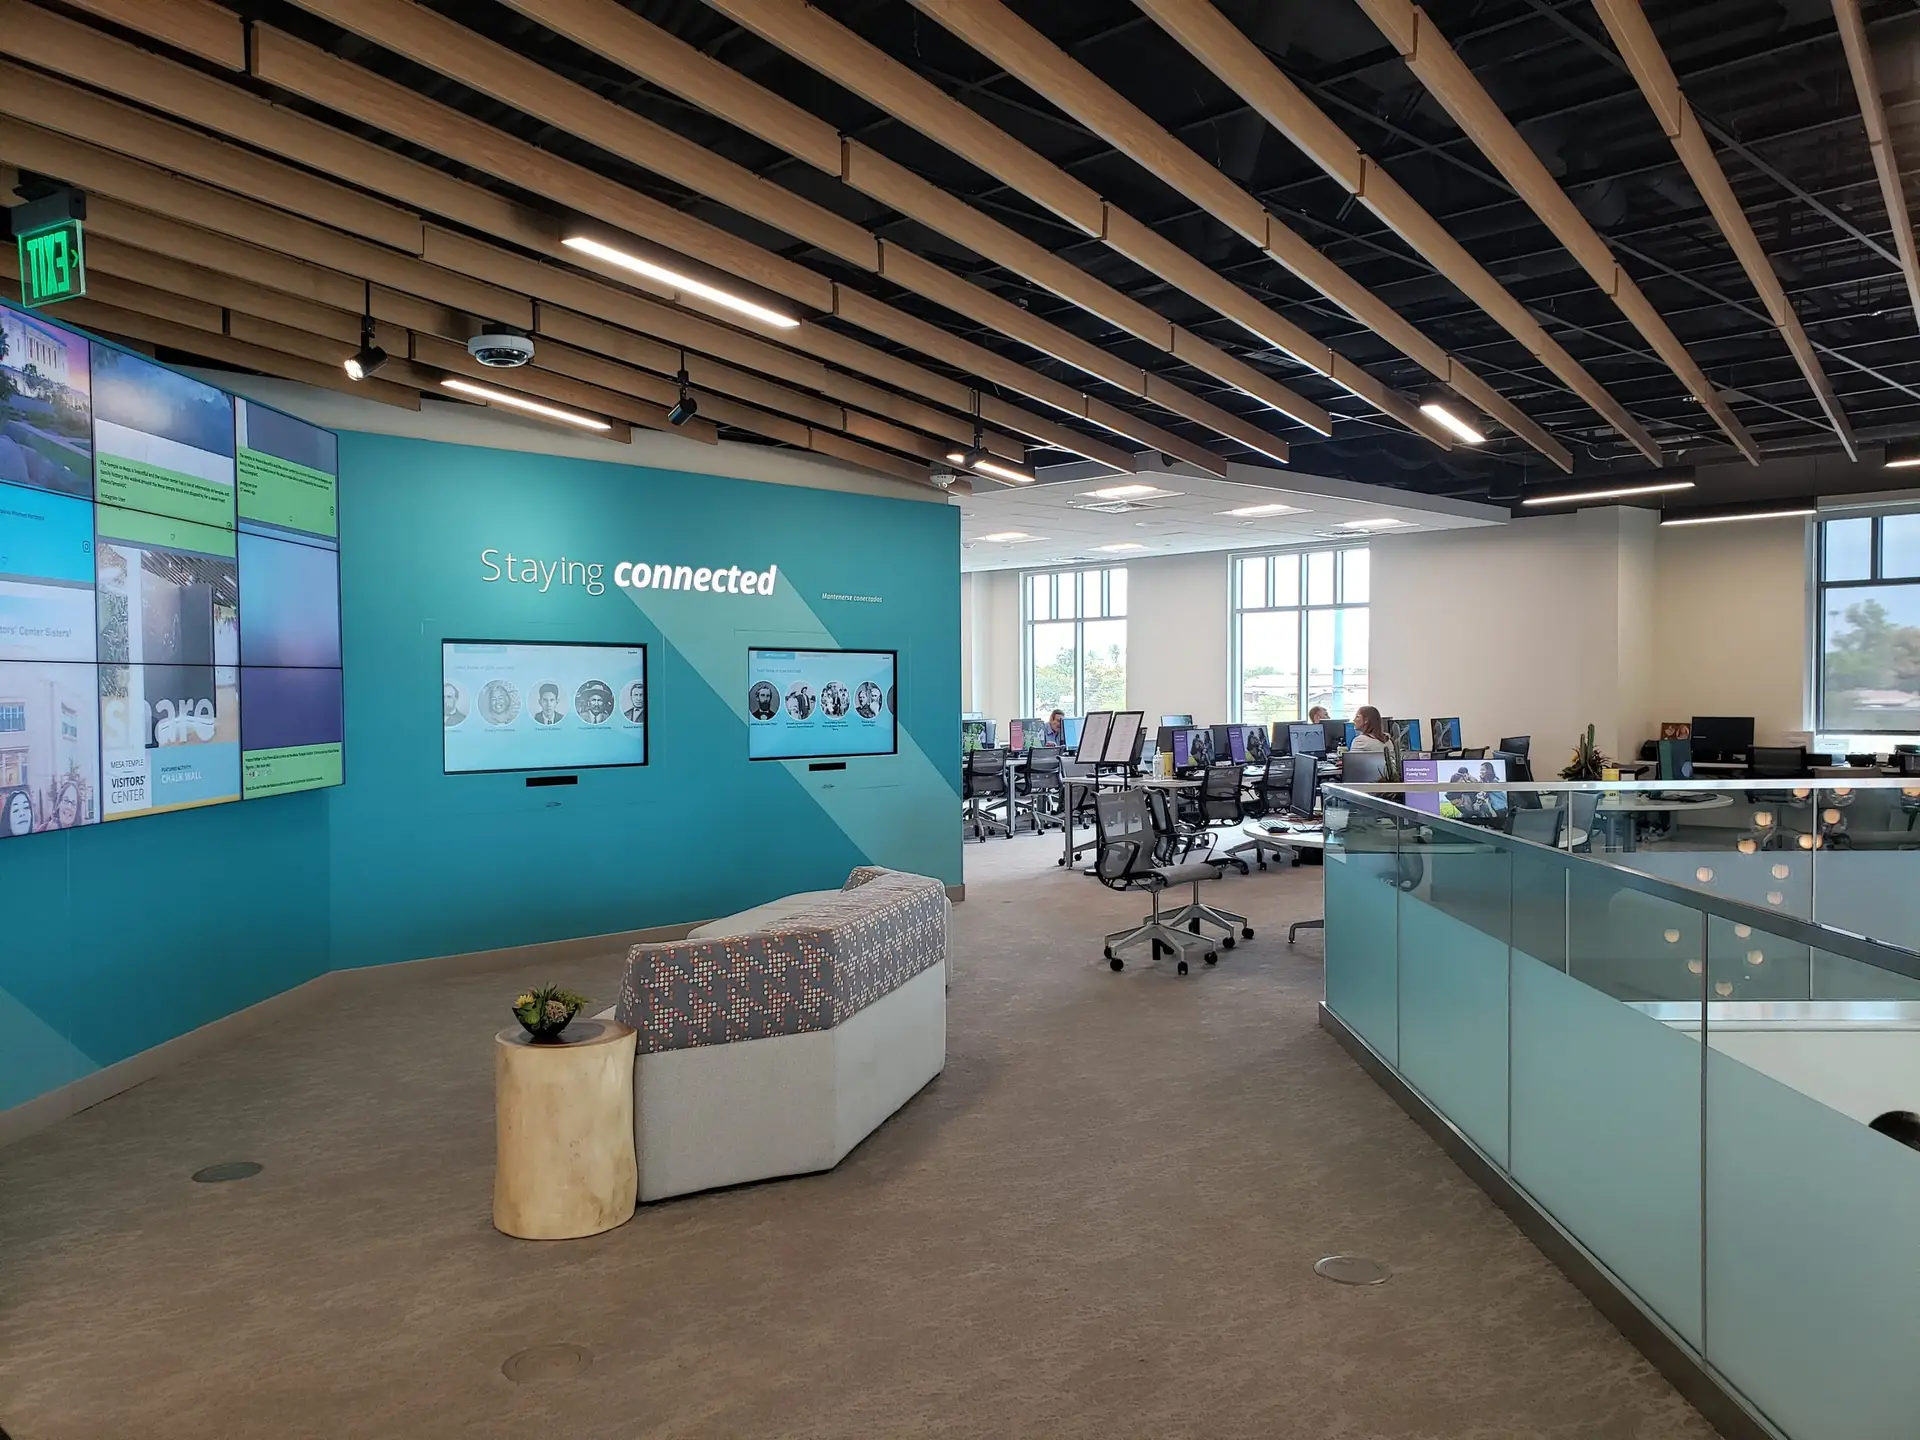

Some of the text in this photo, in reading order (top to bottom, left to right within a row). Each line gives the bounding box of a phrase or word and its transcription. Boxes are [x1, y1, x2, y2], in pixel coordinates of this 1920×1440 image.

[480, 548, 777, 596] Staying connected
[821, 592, 853, 601] Mantenerse
[19, 625, 44, 636] Center
[111, 759, 144, 769] MESA TEMPLE
[111, 775, 146, 789] VISITORS'
[161, 771, 202, 784] CHALK WALL
[111, 788, 145, 804] CENTER
